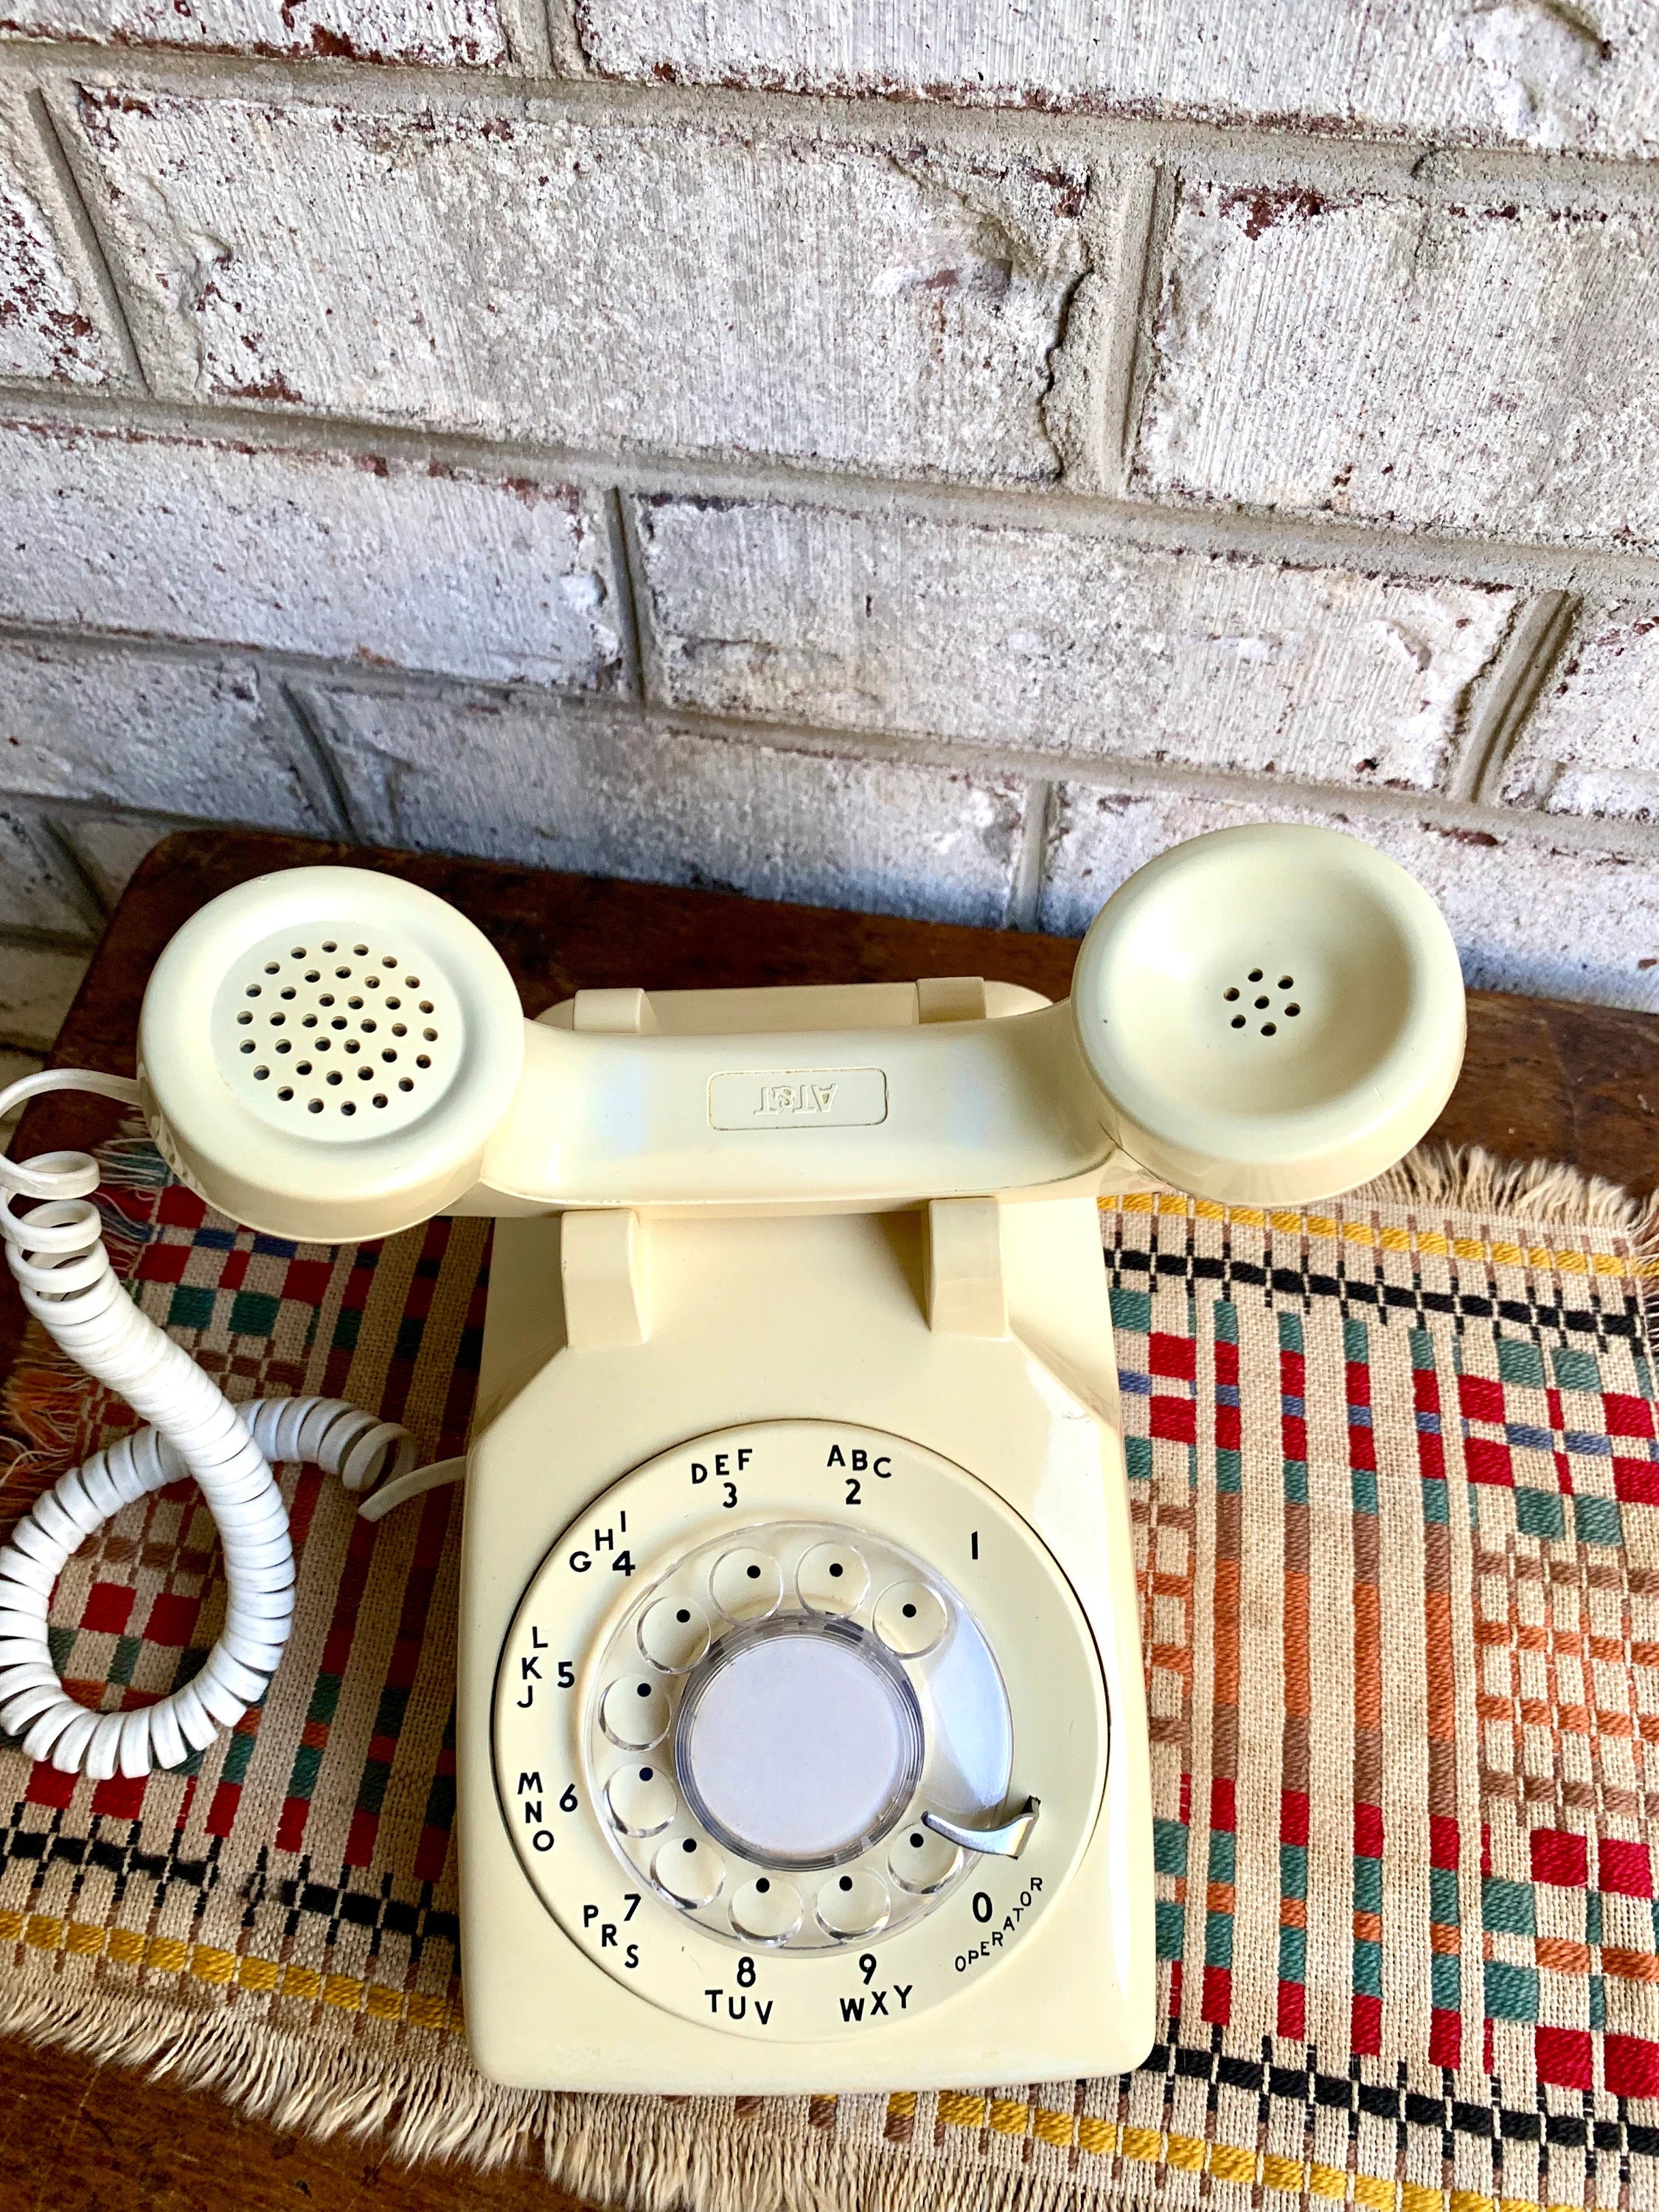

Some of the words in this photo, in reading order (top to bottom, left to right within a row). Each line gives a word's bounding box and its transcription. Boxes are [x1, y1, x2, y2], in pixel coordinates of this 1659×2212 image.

[753, 1082, 839, 1115] AT&T
[691, 1448, 753, 1484] DEF
[827, 1444, 891, 1478] ABC
[722, 1482, 738, 1509] 3
[846, 1478, 861, 1505] 2
[612, 1551, 636, 1576] 4
[557, 1661, 575, 1688] 5
[559, 1784, 578, 1812] 6
[623, 1893, 641, 1921] 7
[955, 1877, 1043, 1972] OPERATOR
[737, 1956, 756, 1988] 8
[858, 1953, 877, 1985] 9
[705, 1989, 773, 2025] TUV
[839, 1985, 913, 2022] WXY
